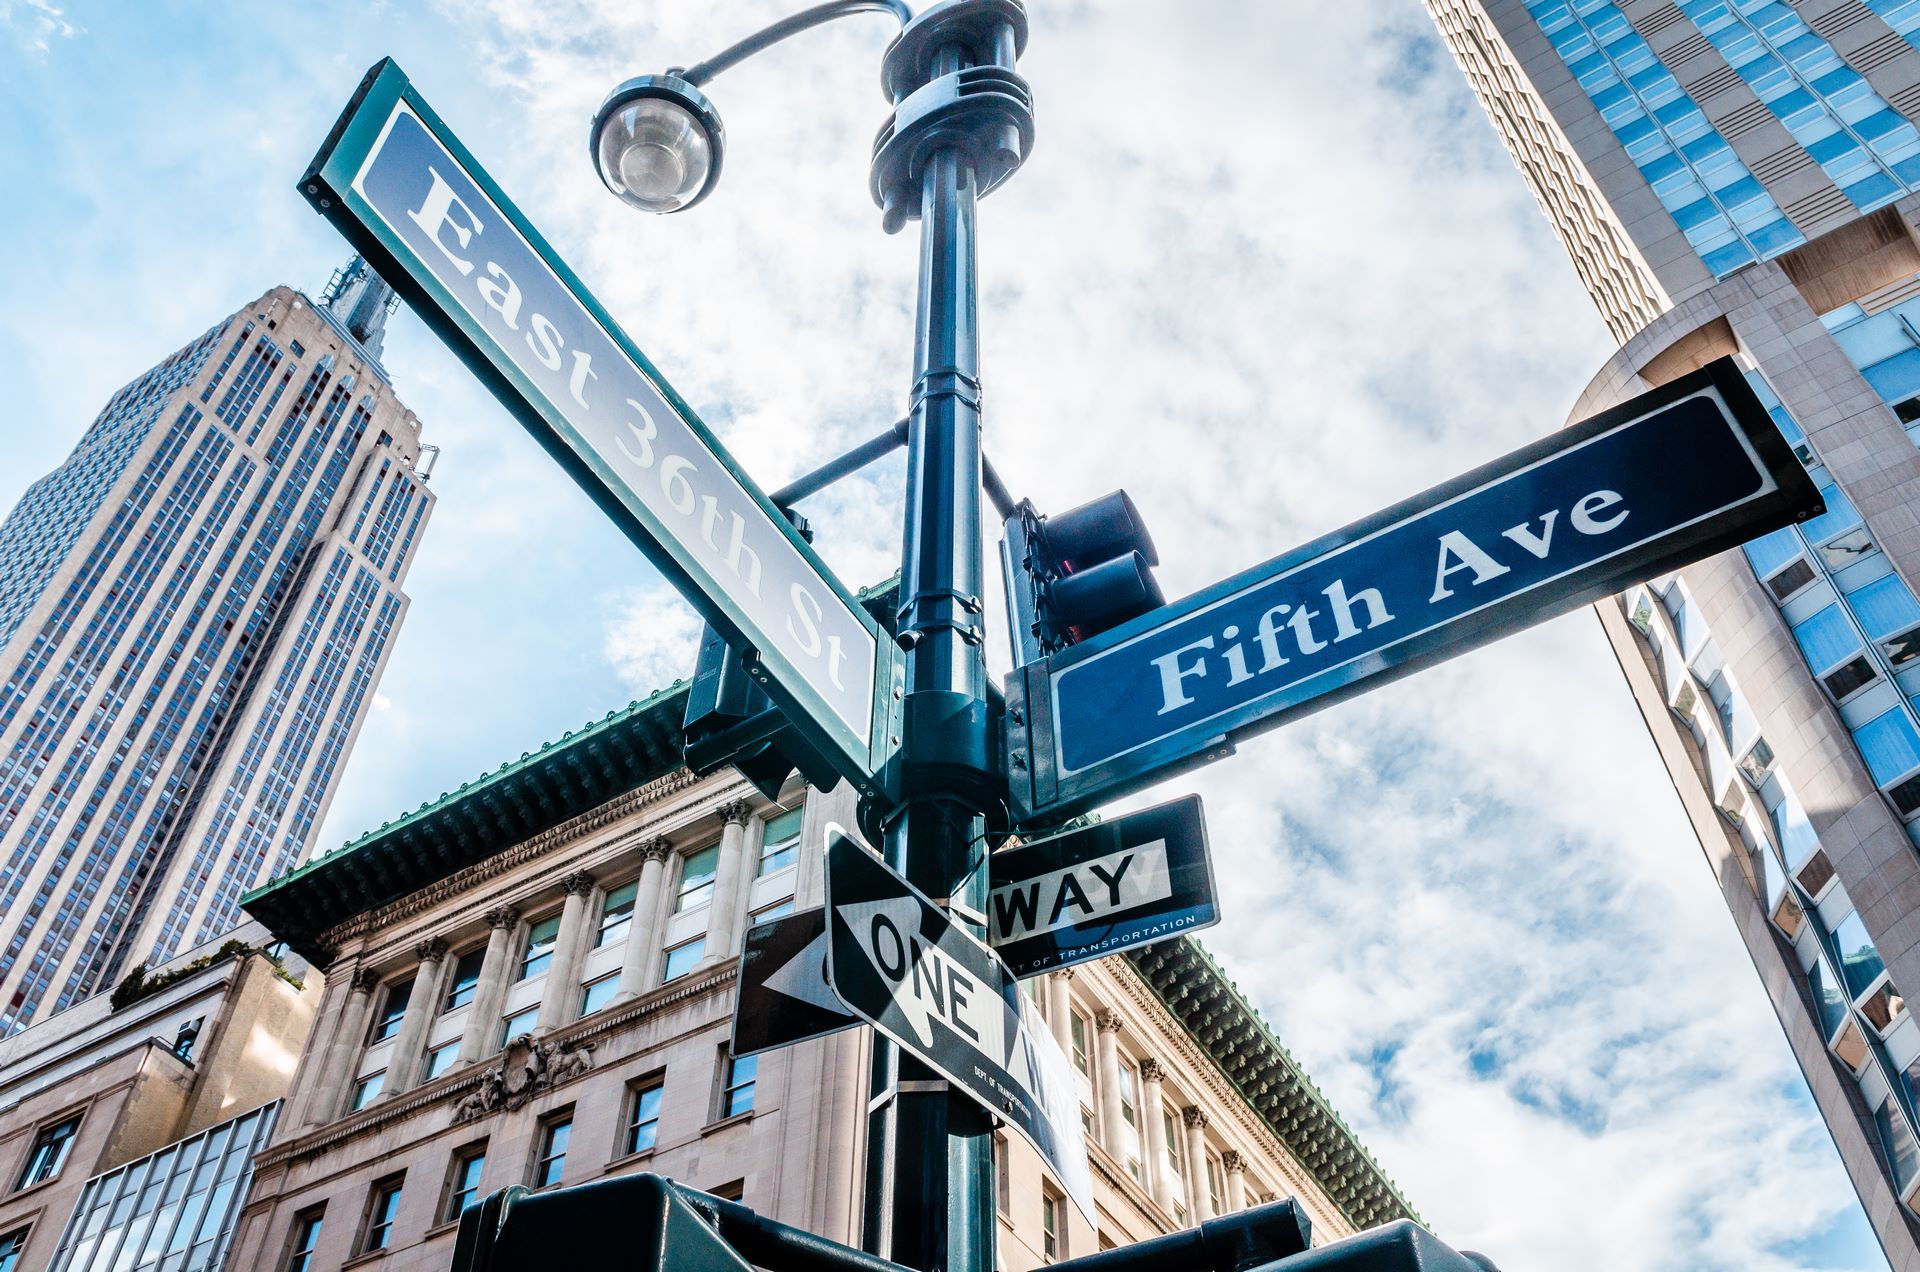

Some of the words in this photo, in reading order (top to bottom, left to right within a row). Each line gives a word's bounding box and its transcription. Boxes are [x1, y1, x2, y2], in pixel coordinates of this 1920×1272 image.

[407, 165, 600, 411] East
[615, 398, 763, 600] 36th
[786, 583, 848, 694] St
[1150, 577, 1395, 716] Fifth
[1429, 489, 1630, 604] Ave
[994, 854, 1135, 939] WAY
[1033, 956, 1051, 968] OF
[1059, 914, 1196, 960] TRANSPORTATION
[871, 913, 979, 1043] ONE
[989, 1076, 996, 1088] OF
[997, 1082, 1033, 1120] TRANSPORTATION
